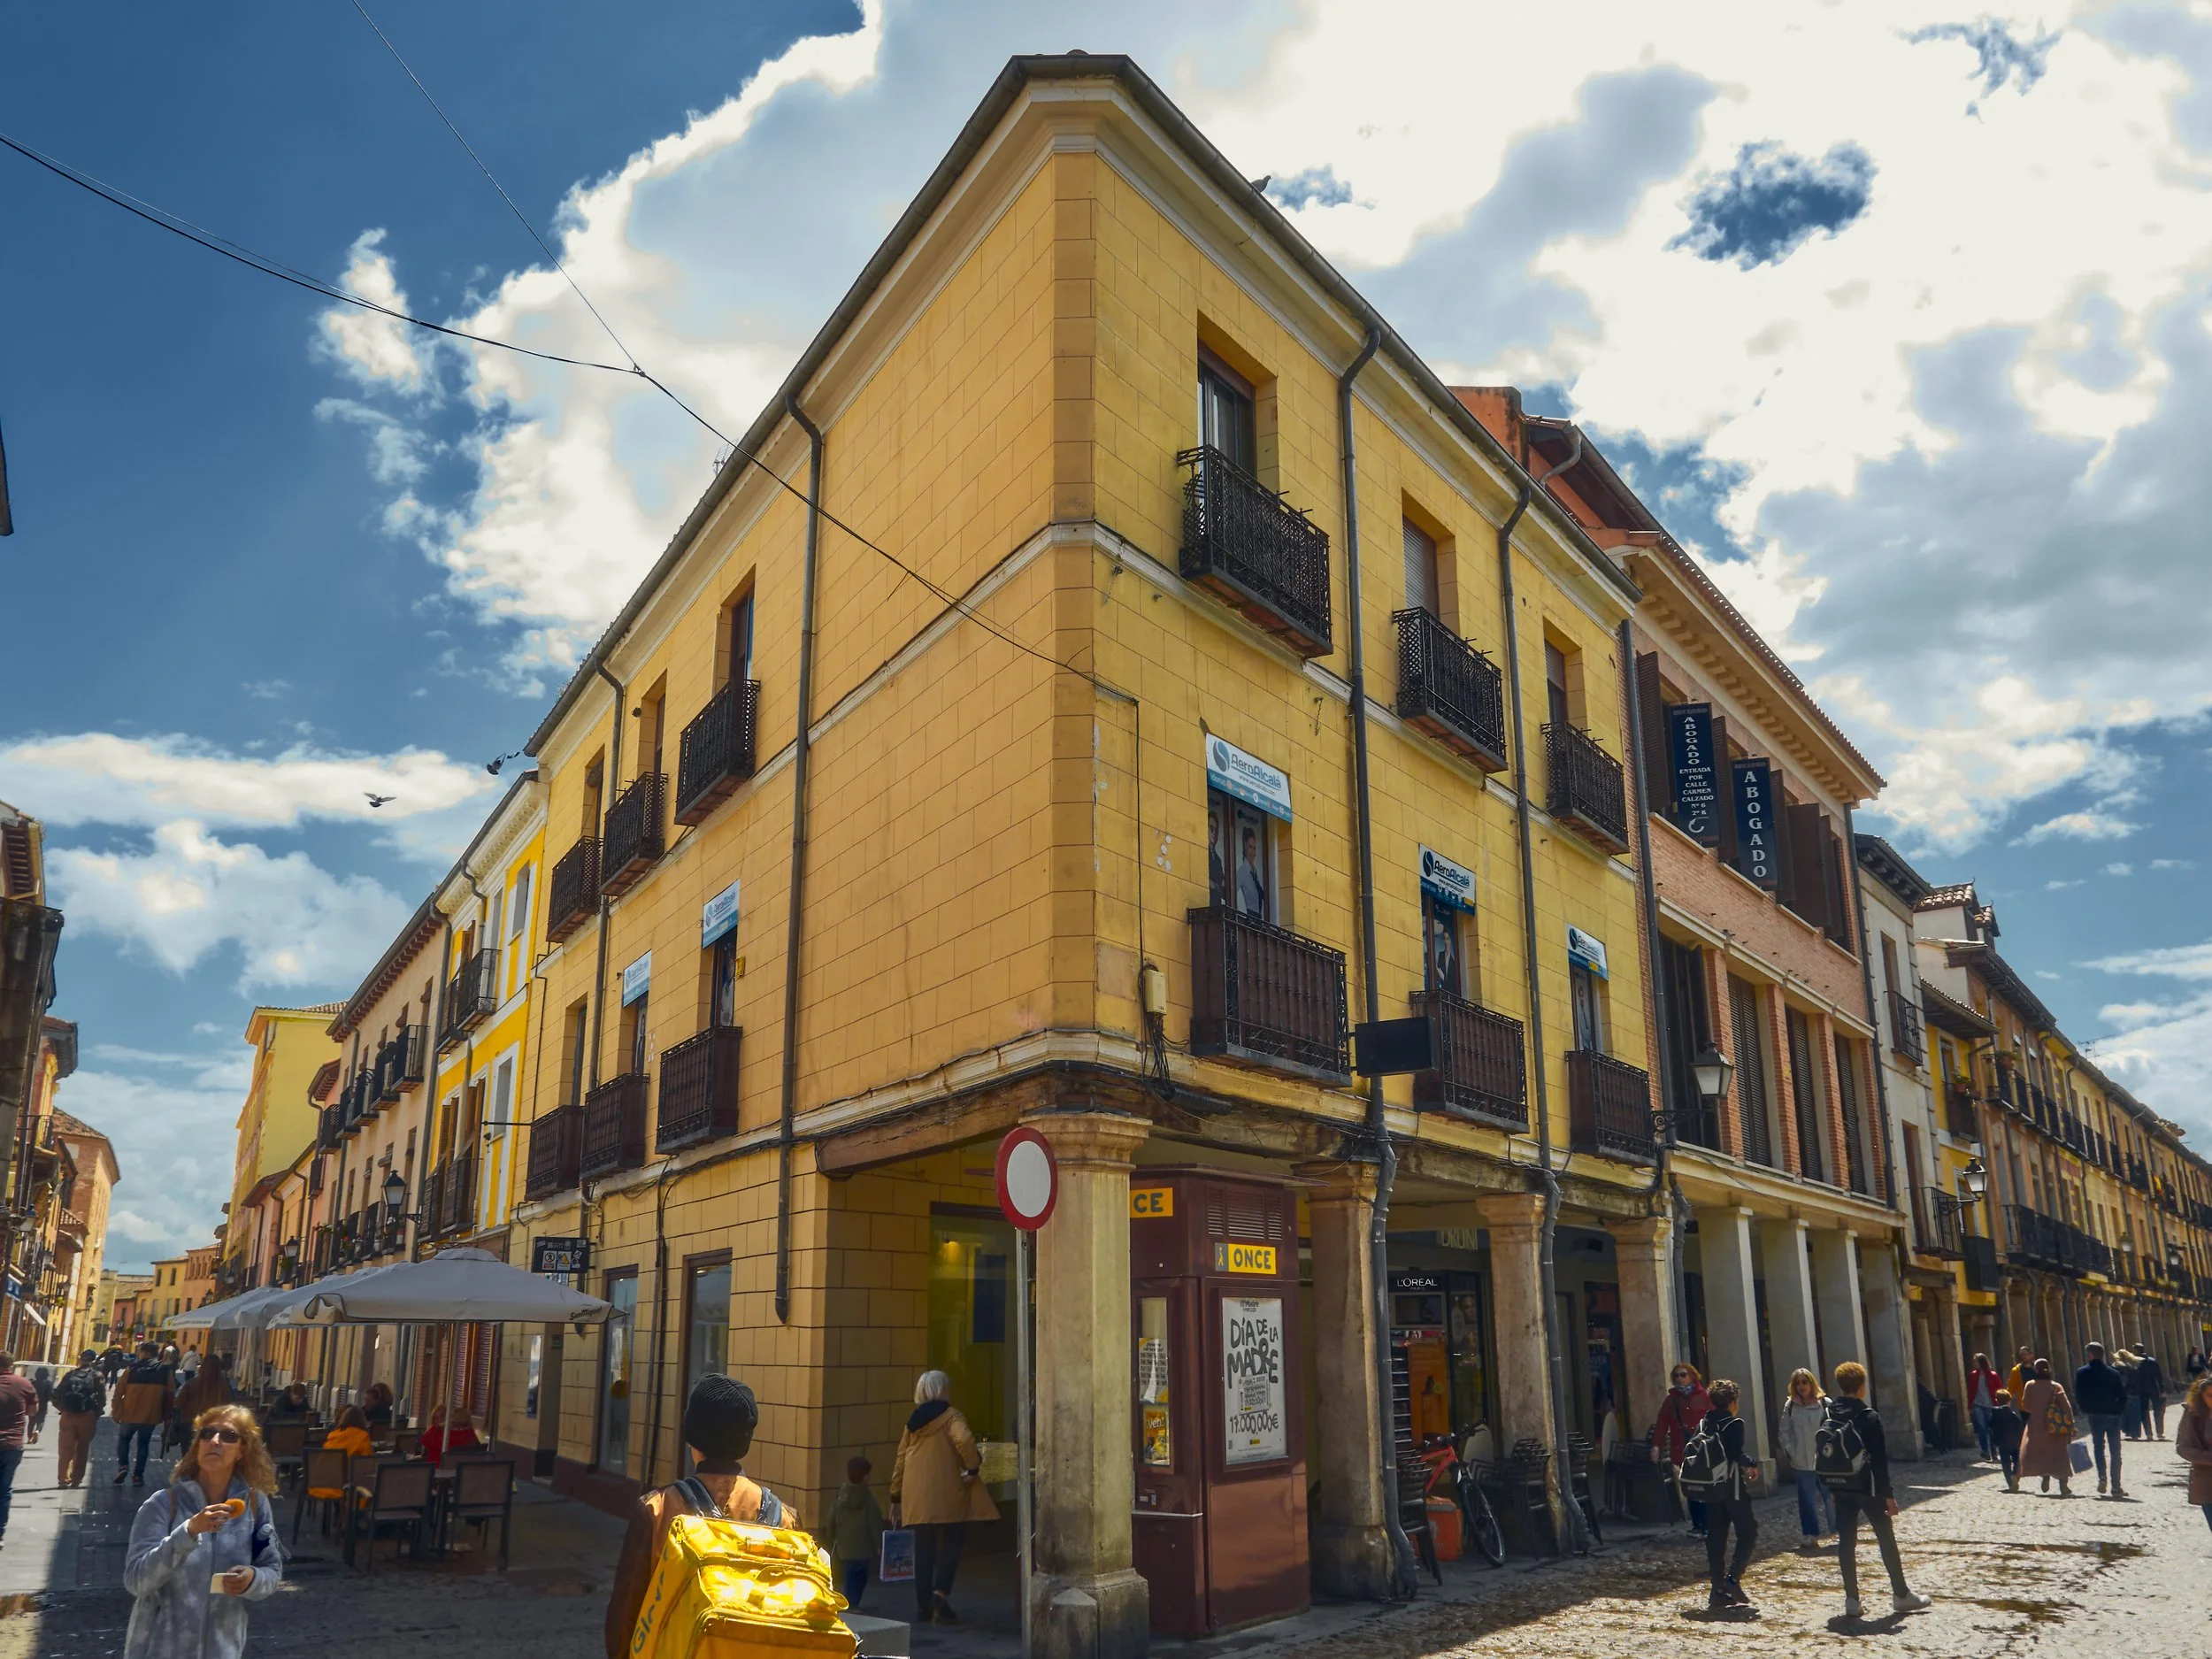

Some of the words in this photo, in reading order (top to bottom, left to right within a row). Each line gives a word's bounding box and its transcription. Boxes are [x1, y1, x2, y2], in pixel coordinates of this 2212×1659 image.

[1684, 717, 1700, 764] ABOGADO
[1231, 753, 1282, 789] AeroAlcalá
[1744, 771, 1767, 878] ABOGADO
[1133, 1193, 1164, 1213] CE
[1233, 1248, 1271, 1270] ONCE
[1256, 1318, 1268, 1336] DE
[1269, 1326, 1279, 1342] LA
[1227, 1338, 1279, 1389] MADRE
